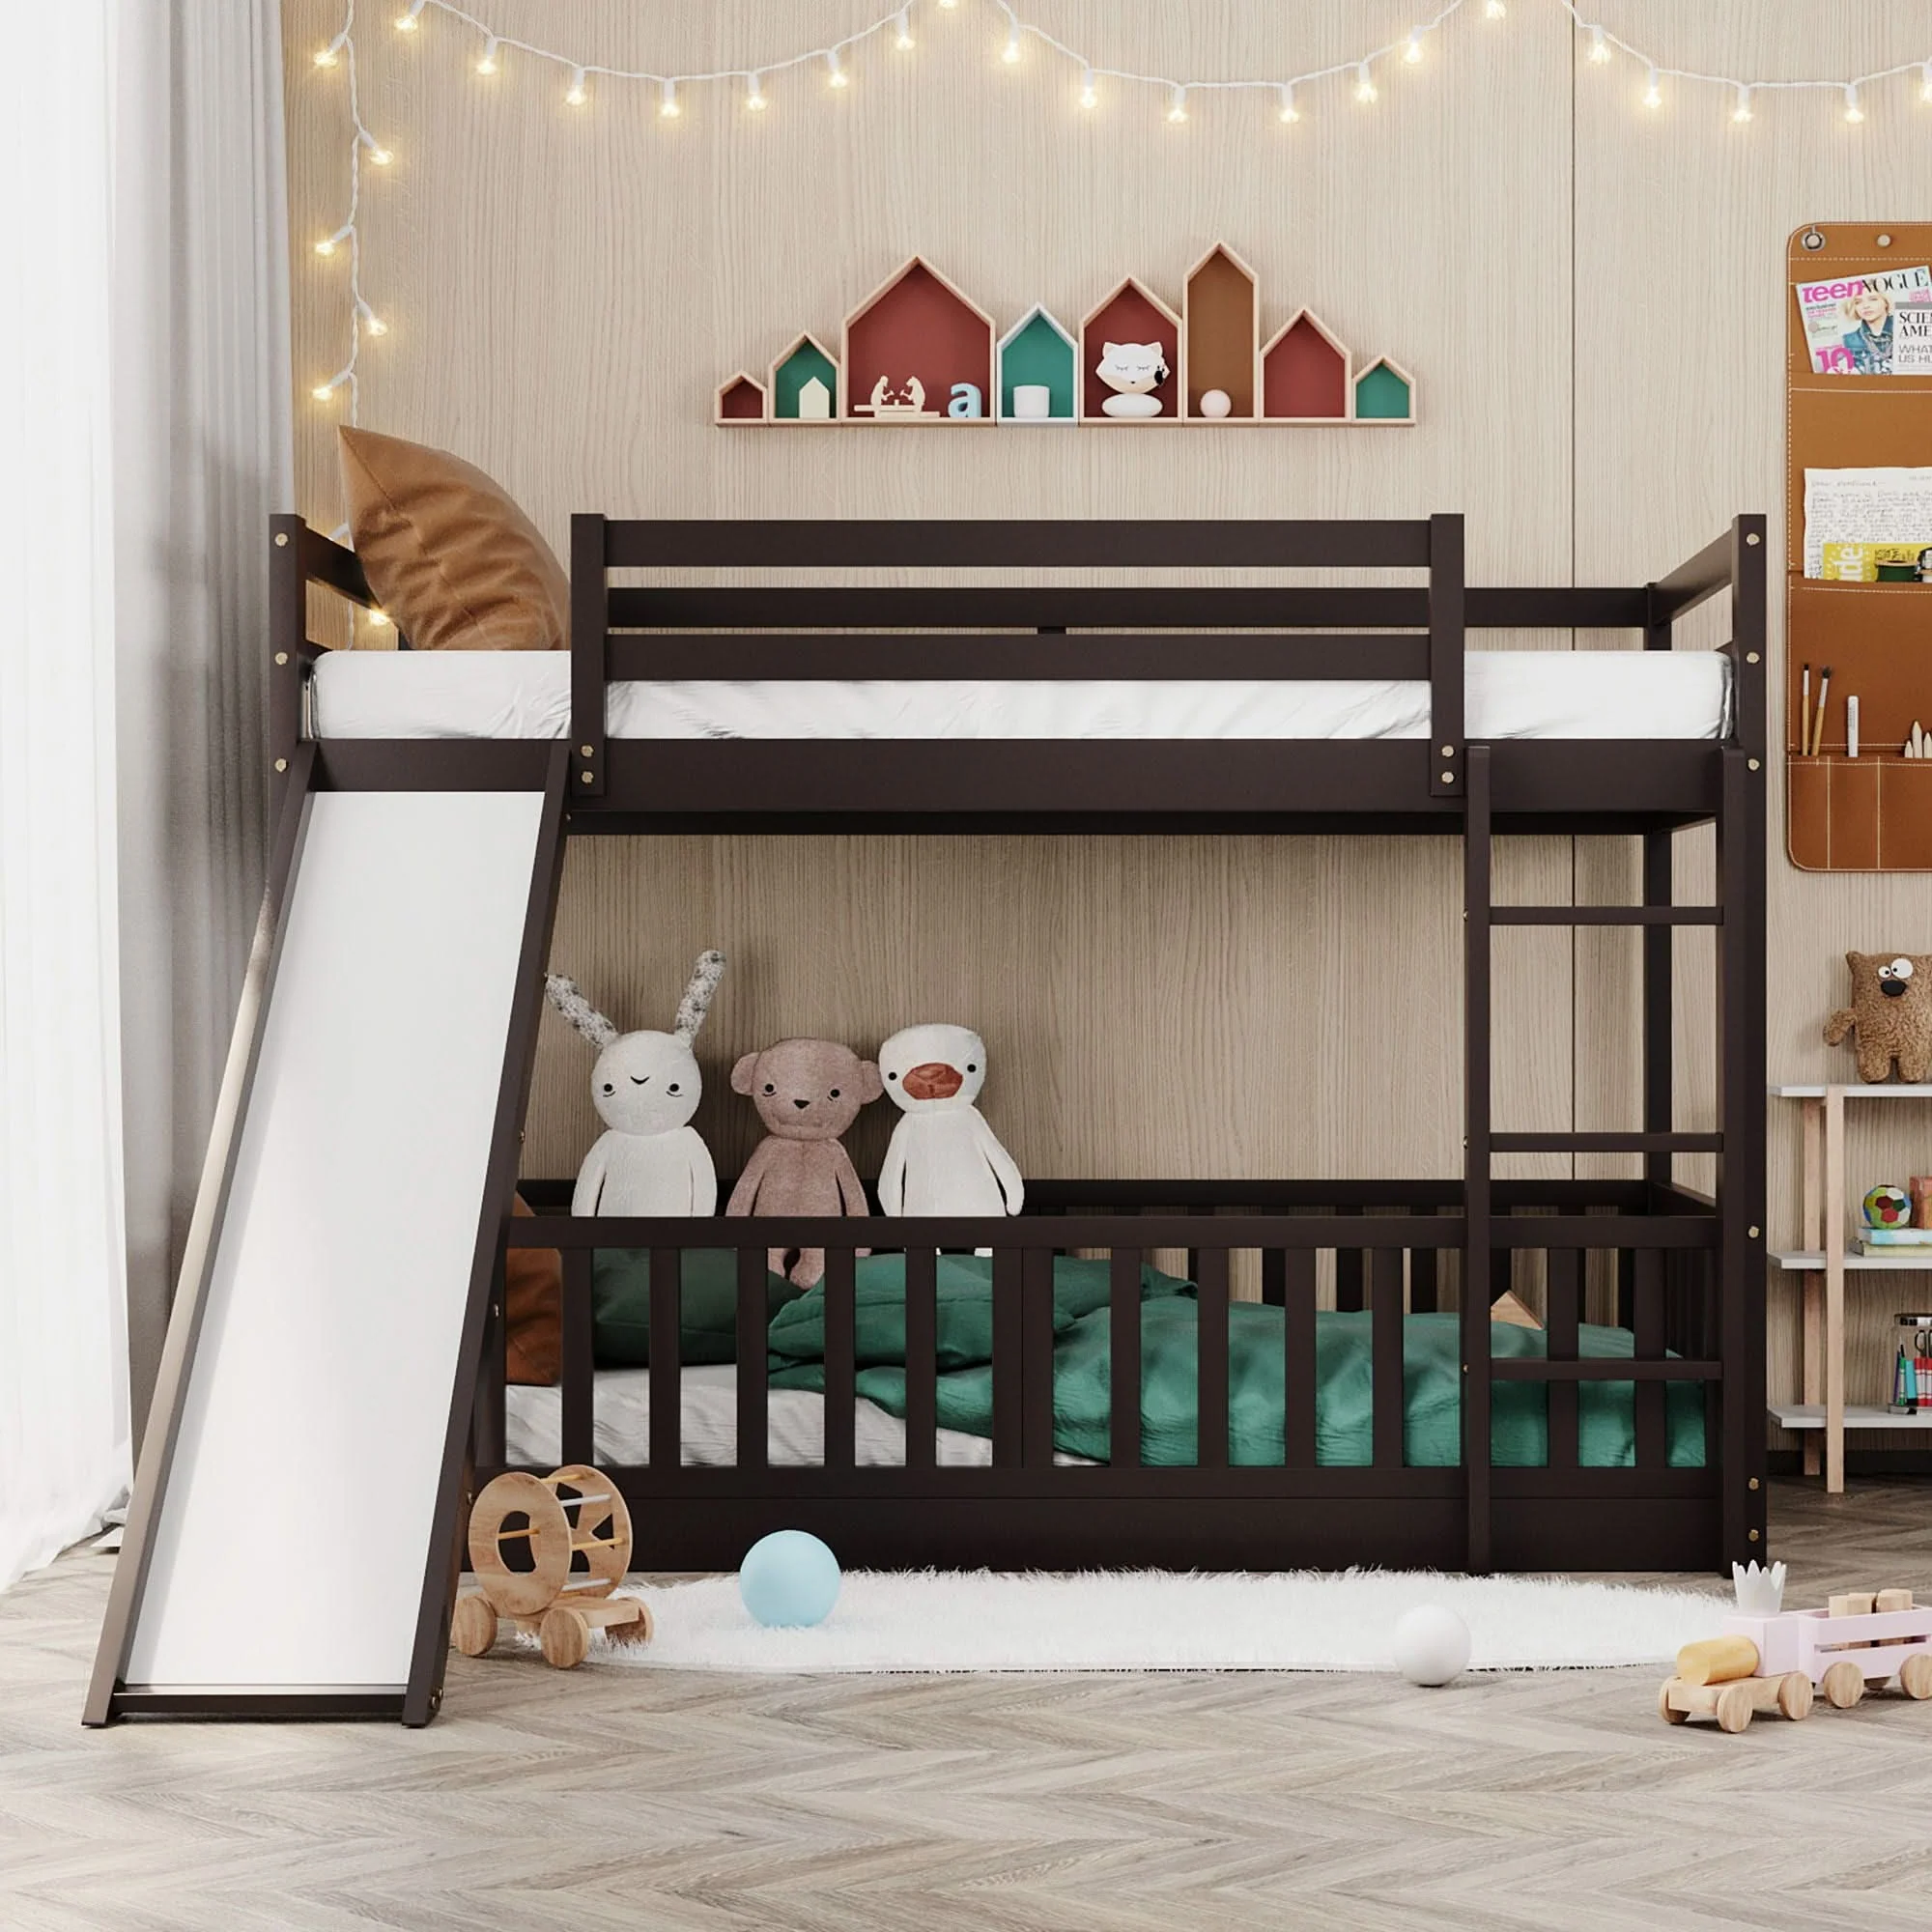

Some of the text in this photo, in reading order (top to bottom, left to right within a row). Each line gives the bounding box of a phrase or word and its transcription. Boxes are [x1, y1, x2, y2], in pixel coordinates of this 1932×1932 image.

[1803, 269, 1928, 303] teen VOGUE
[948, 383, 981, 417] a
